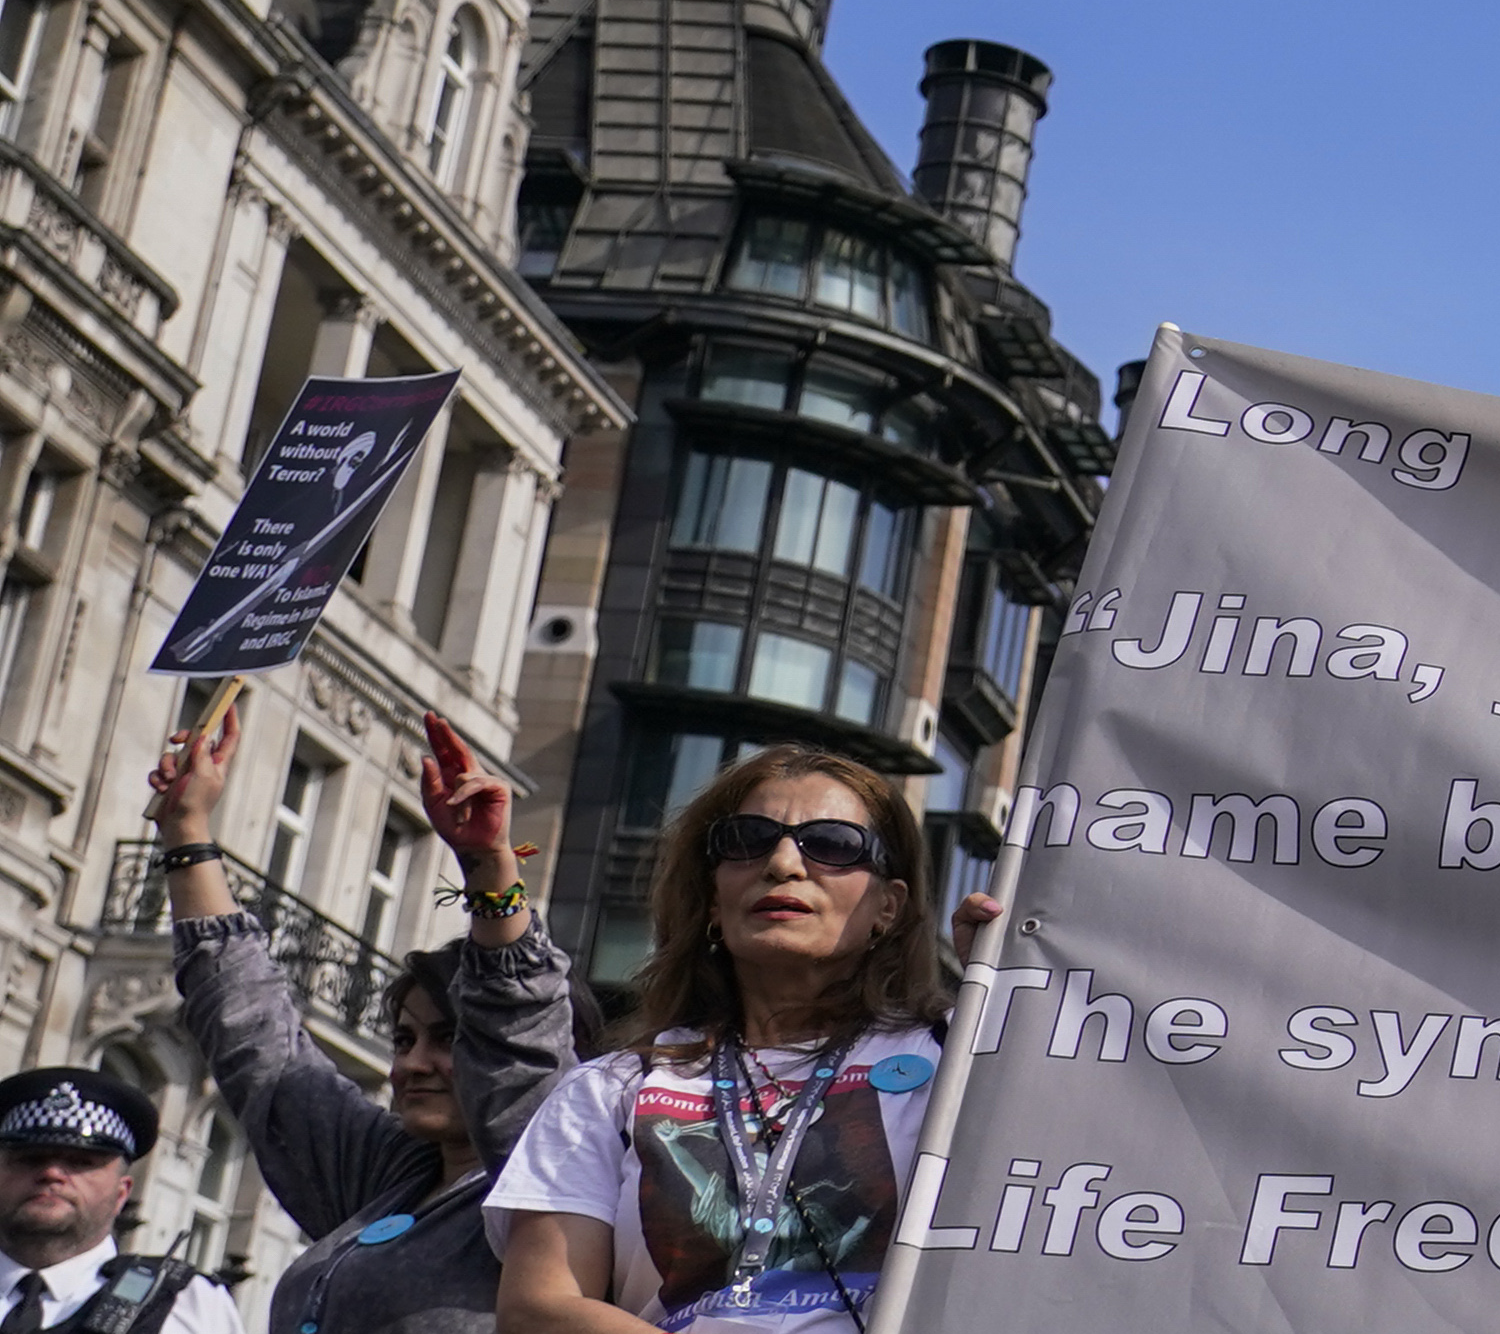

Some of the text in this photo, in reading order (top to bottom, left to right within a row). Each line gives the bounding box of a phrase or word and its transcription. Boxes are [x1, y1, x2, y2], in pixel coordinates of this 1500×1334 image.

[290, 420, 354, 438] A world
[1158, 368, 1473, 492] Long
[279, 444, 341, 461] without
[267, 464, 326, 483] Terror?
[252, 517, 295, 535] There
[237, 540, 287, 561] is only
[208, 563, 277, 579] one WAY
[273, 587, 291, 604] To
[241, 611, 288, 631] Regime
[239, 632, 267, 651] and
[1065, 587, 1448, 704] “Jina,
[1004, 779, 1391, 873] name
[960, 963, 1230, 1066] The
[637, 1091, 716, 1114] Woma
[895, 1150, 1186, 1263] Life
